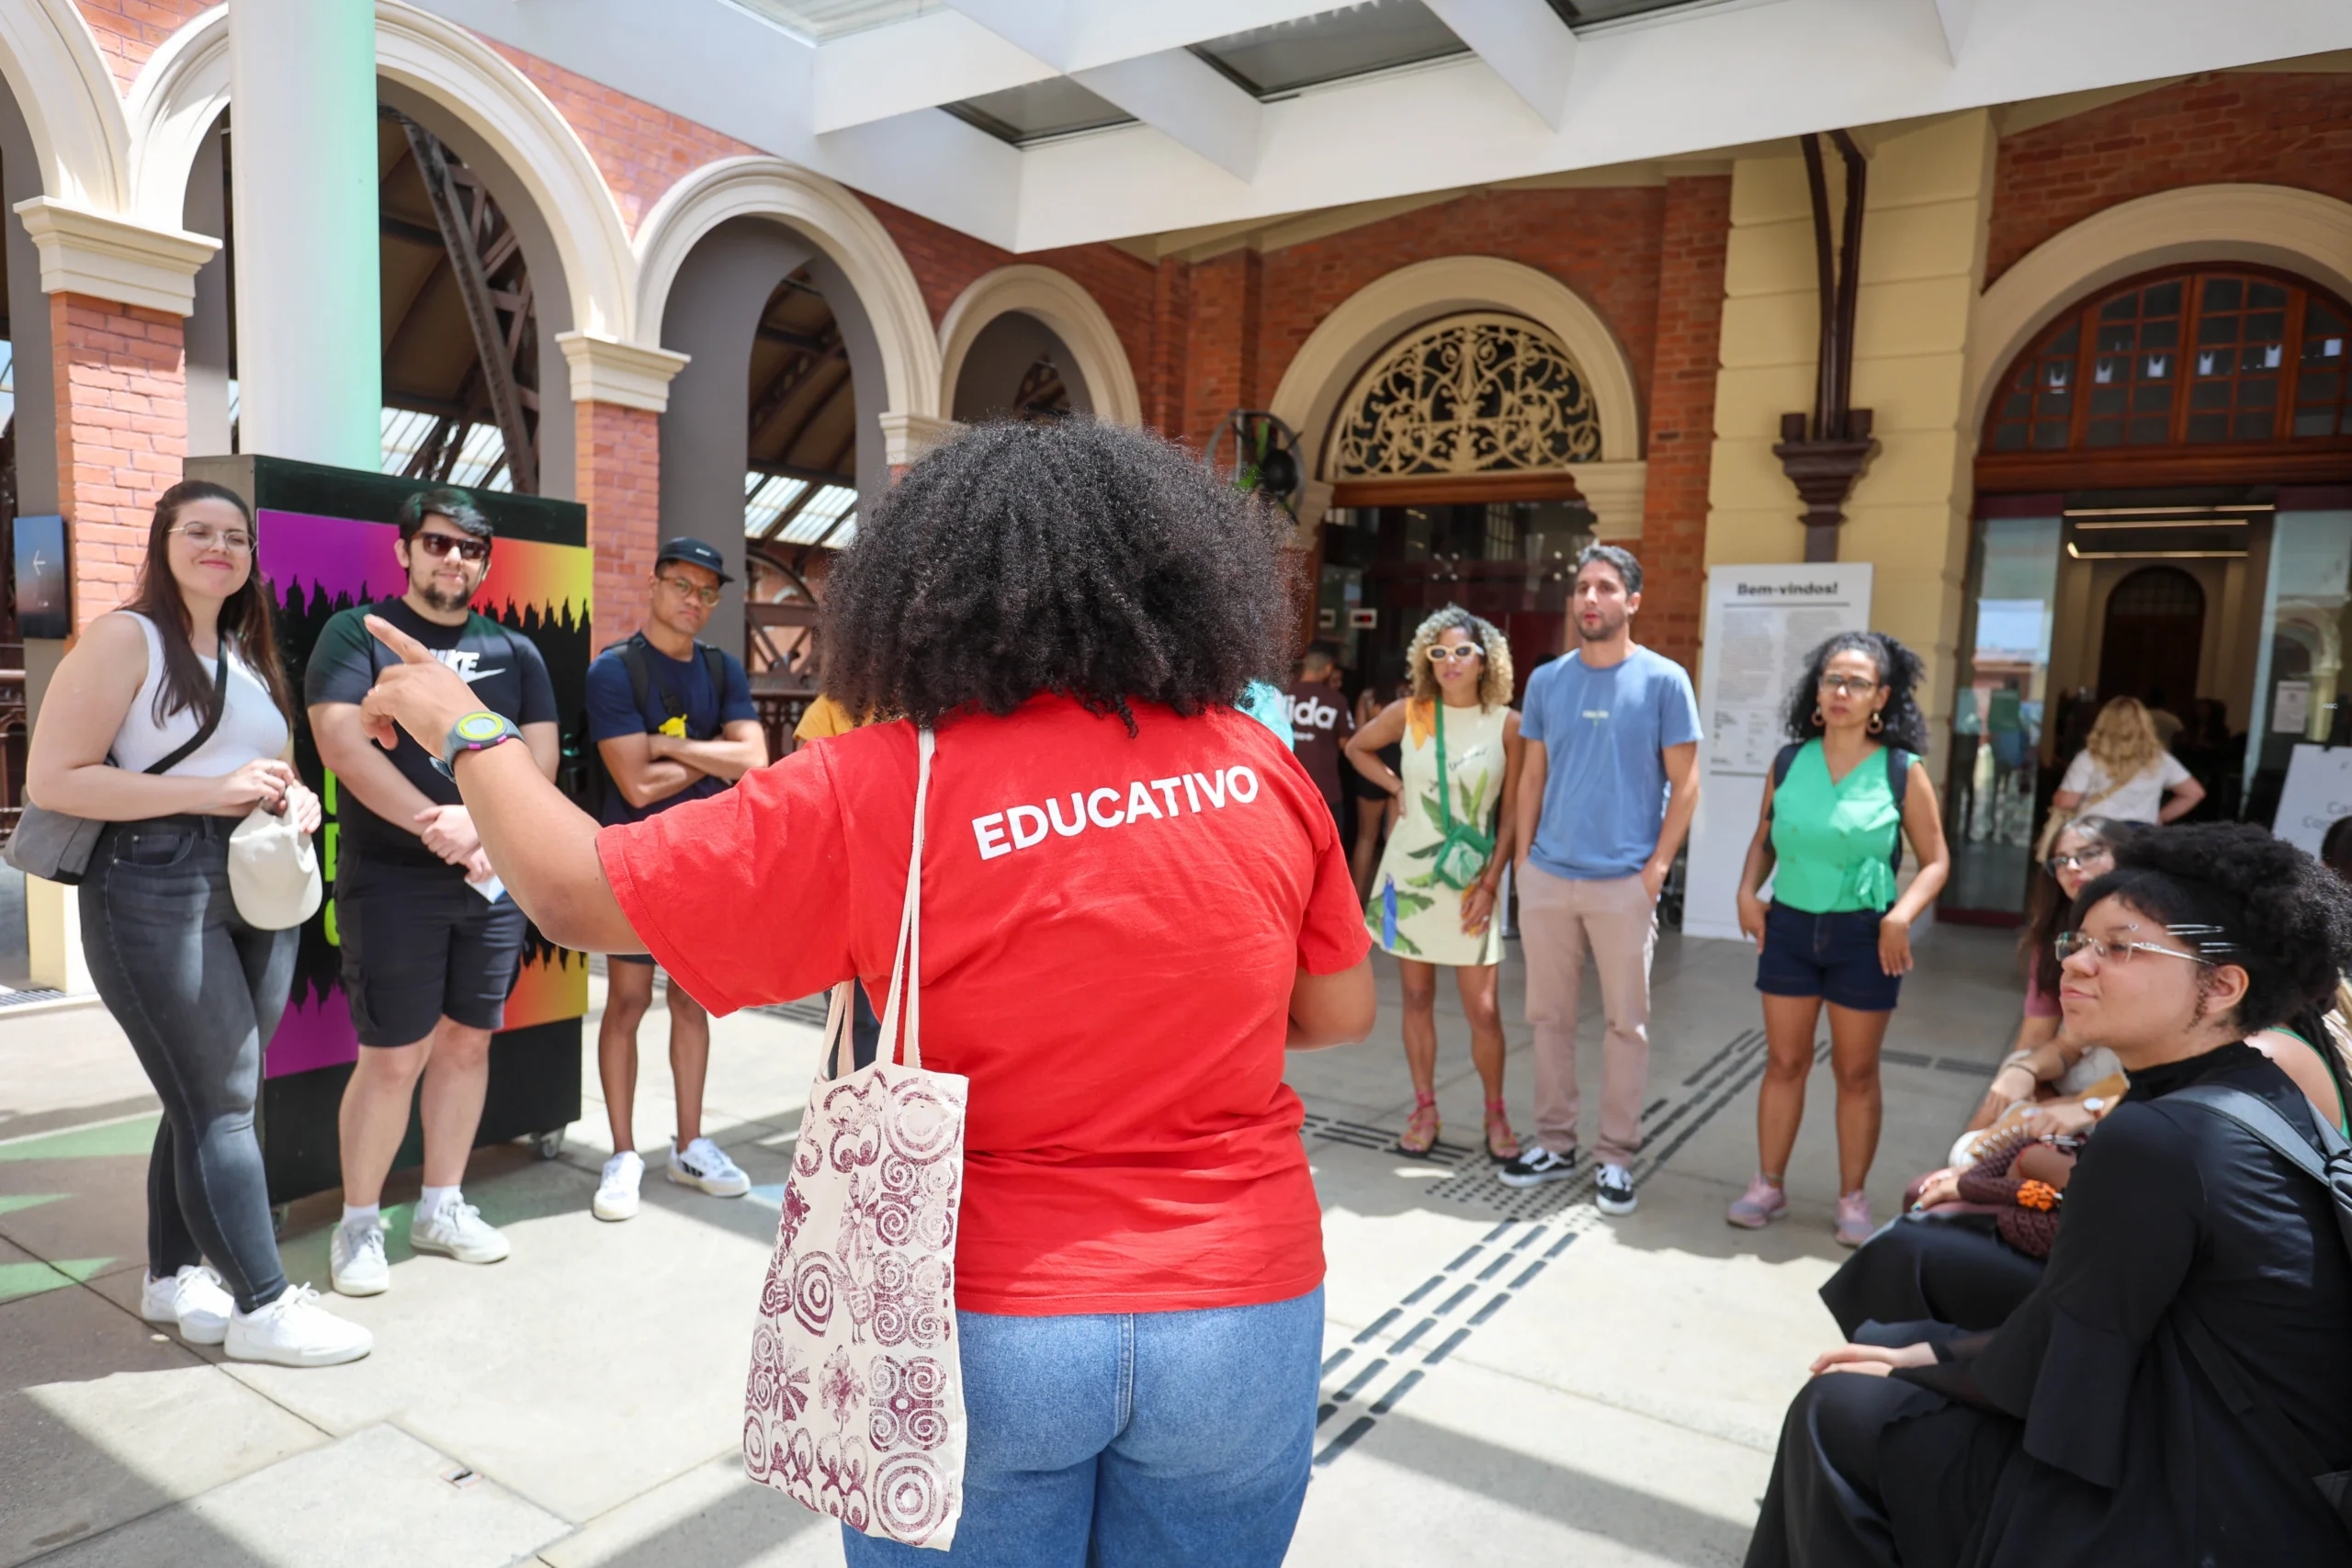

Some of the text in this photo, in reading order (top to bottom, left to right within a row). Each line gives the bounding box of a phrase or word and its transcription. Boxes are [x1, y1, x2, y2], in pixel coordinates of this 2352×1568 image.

[1736, 582, 1838, 596] Bem-vindos!
[429, 649, 480, 676] KE
[971, 765, 1259, 861] EDUCATIVO
